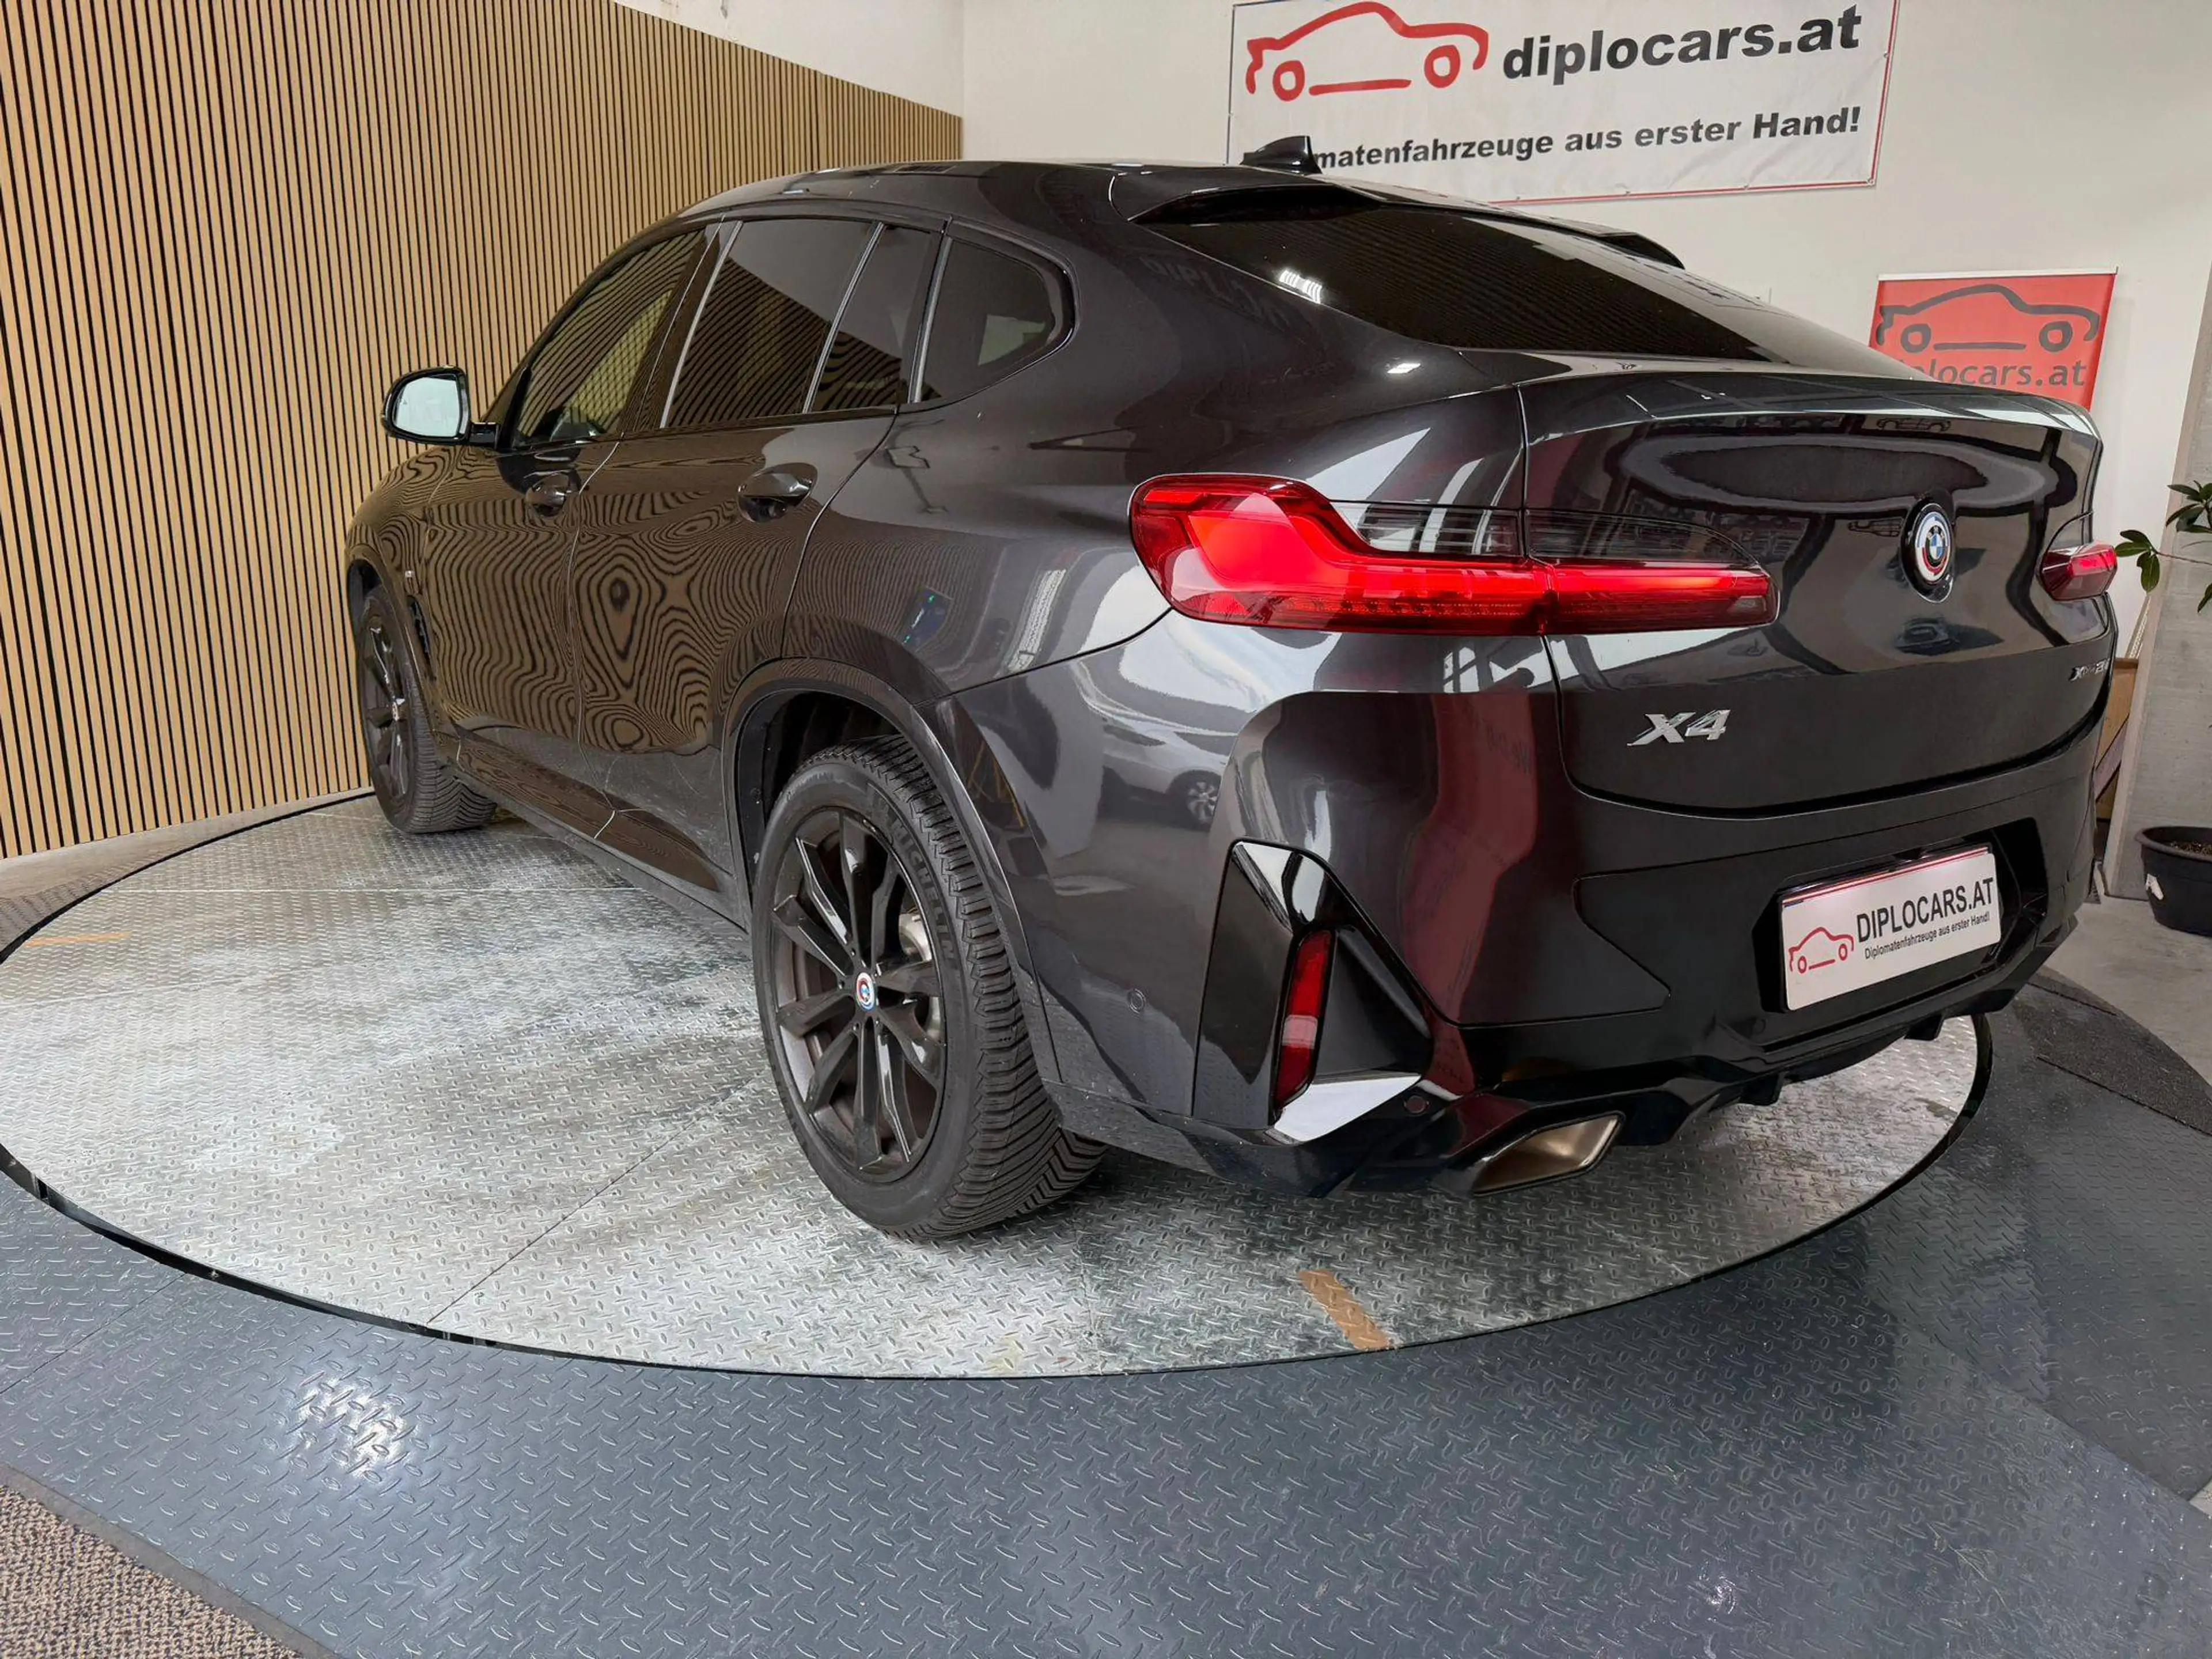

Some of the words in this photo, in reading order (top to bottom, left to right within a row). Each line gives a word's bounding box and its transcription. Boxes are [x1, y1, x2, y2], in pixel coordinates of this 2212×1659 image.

[1504, 5, 1862, 85] diplocars.at
[1315, 137, 1554, 168] matenfahrzeuge
[1565, 127, 1622, 151] aus
[1635, 119, 1741, 146] erster
[1753, 107, 1860, 139] Hand!
[1907, 359, 2086, 386] locars.at
[1627, 710, 1730, 747] X4
[1857, 877, 1994, 942] DIPLOCARS.AT
[1865, 932, 1938, 960] Diplomatenfahrzeuge
[1938, 926, 1950, 937] aus
[1951, 920, 1970, 932] erster
